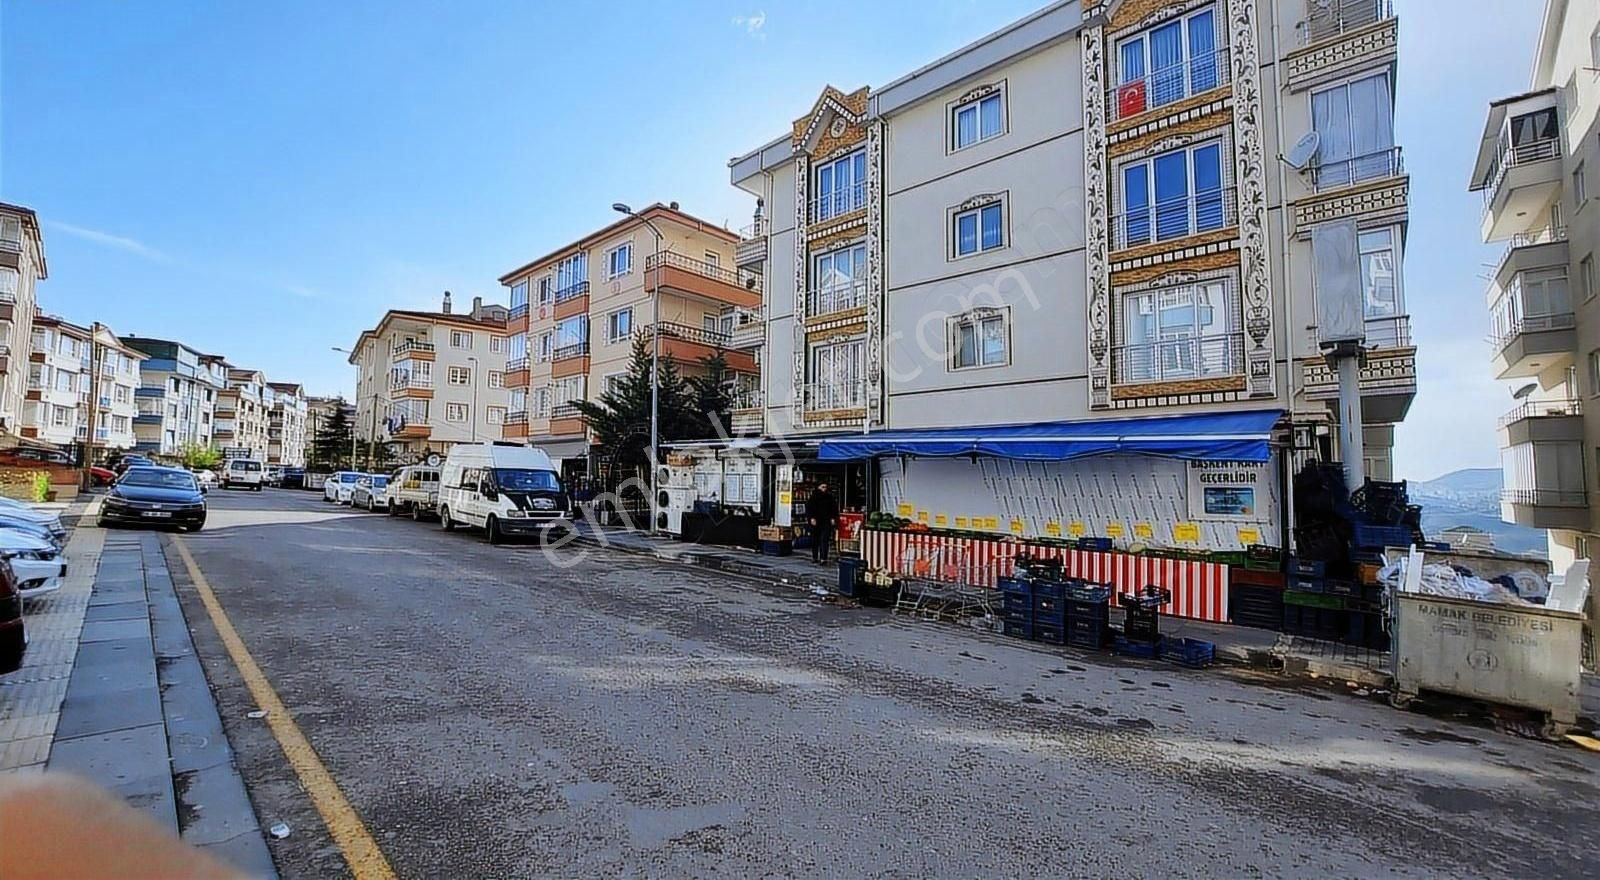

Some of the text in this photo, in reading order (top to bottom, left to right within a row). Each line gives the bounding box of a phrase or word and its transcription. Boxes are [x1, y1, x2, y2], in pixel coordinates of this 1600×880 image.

[1200, 471, 1257, 484] GEÇERLİDİR
[1418, 604, 1554, 632] MAMAK BELEDİYESİ
